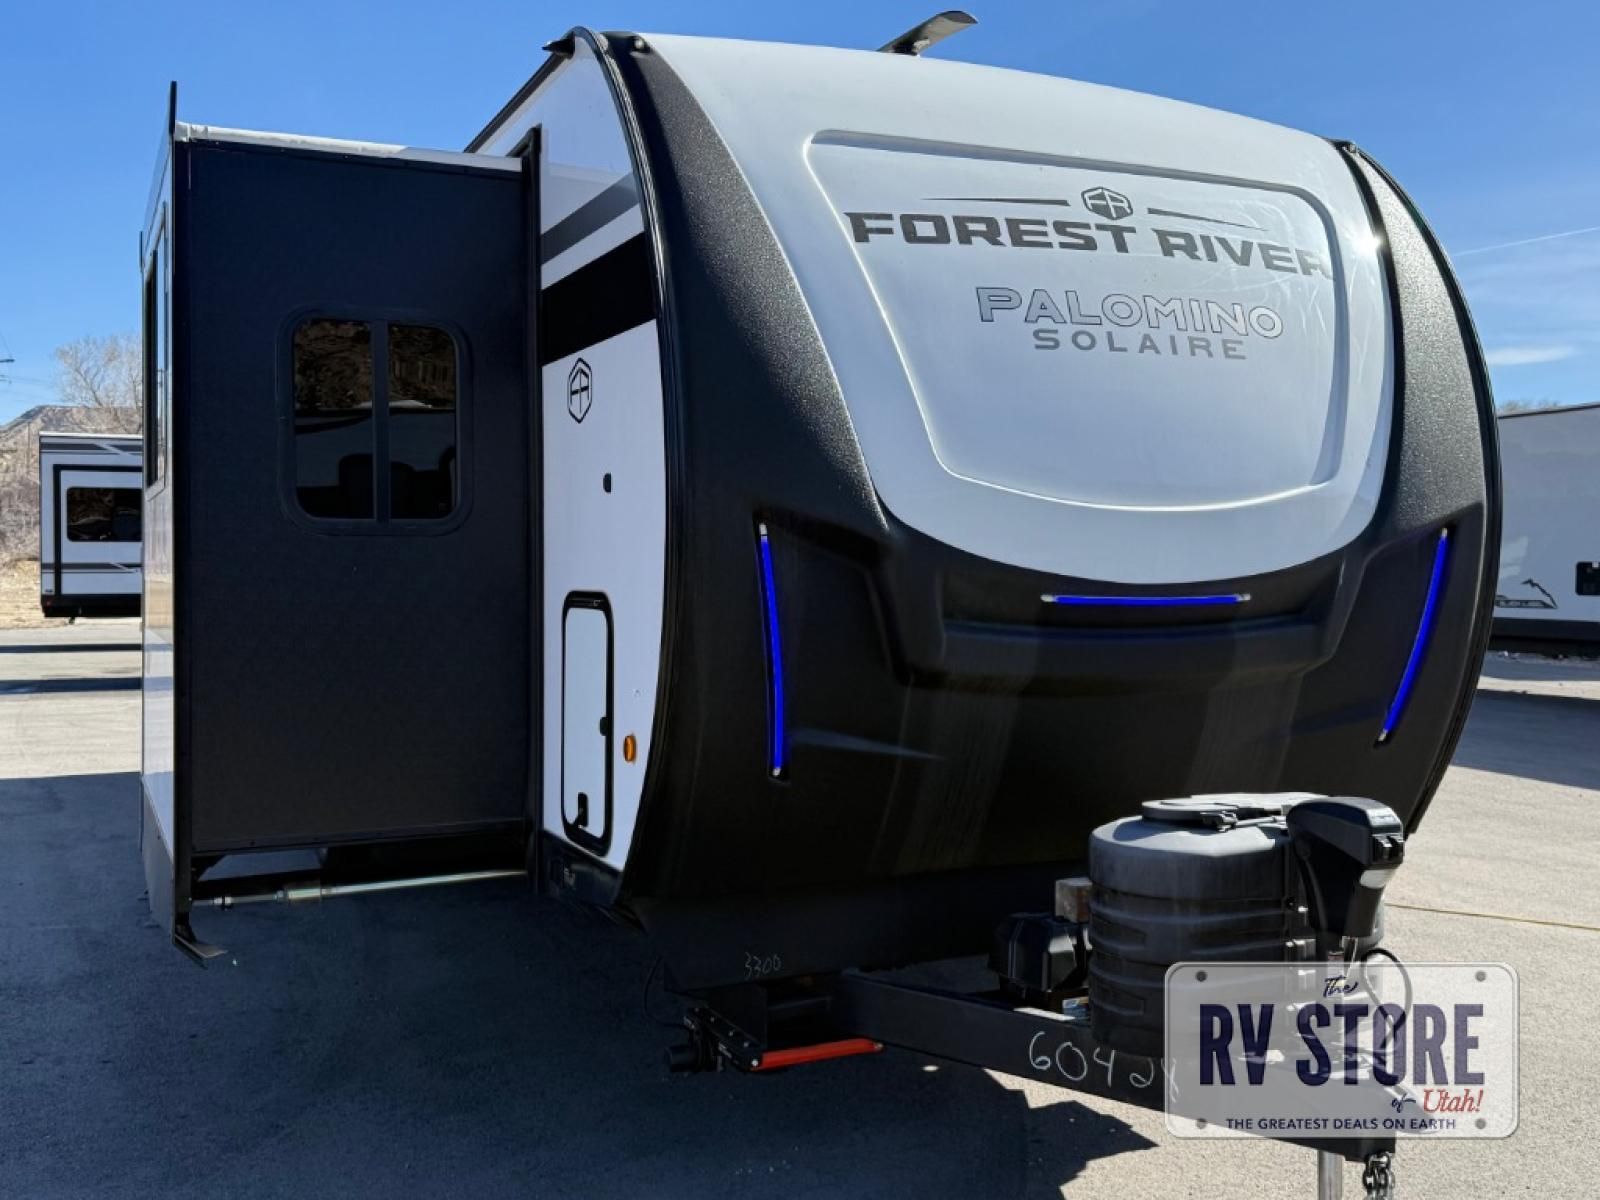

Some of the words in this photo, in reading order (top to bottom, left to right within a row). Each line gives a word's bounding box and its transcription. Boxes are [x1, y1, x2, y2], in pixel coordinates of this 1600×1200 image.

[844, 211, 1137, 254] FOREST
[1151, 227, 1335, 280] RIVER
[976, 286, 1284, 338] PALOMINO
[1033, 328, 1248, 360] SOLAIRE
